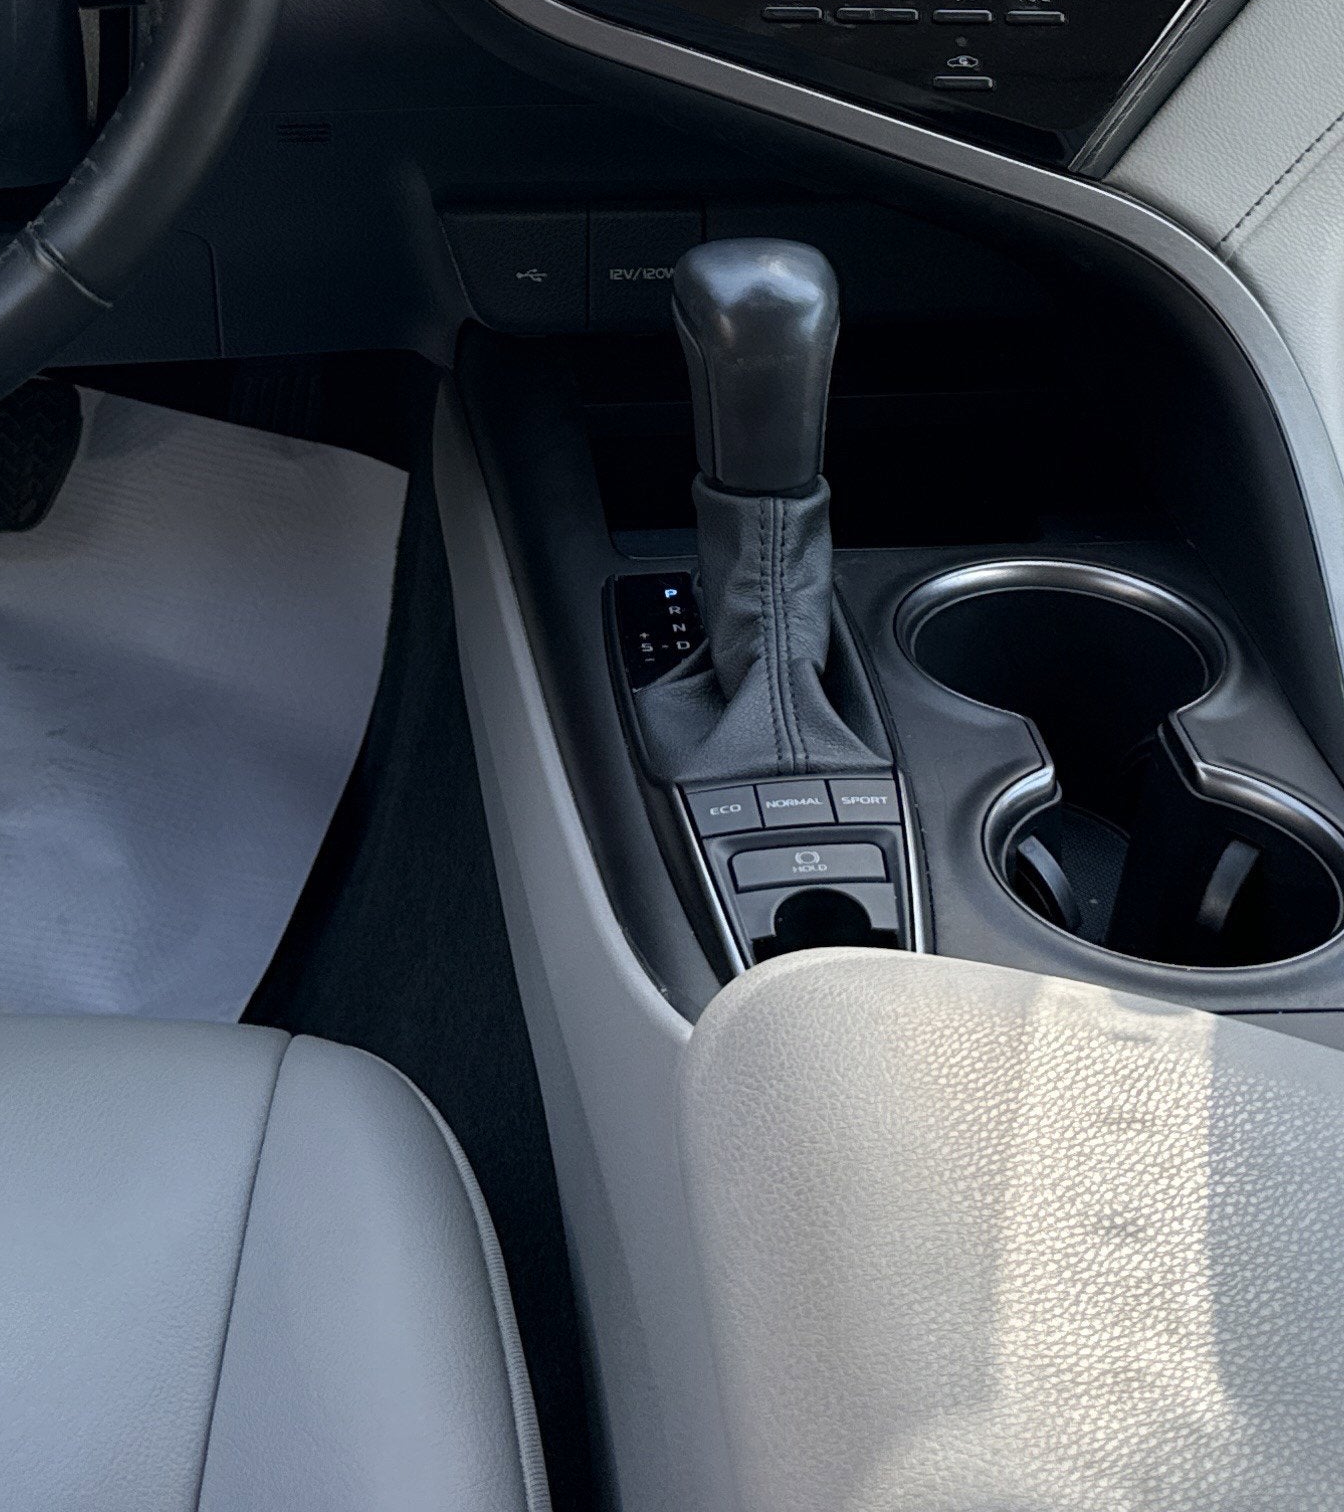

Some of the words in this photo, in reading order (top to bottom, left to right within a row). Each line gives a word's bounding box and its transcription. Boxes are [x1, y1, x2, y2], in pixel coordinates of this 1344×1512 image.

[664, 589, 678, 598] P
[669, 606, 681, 615] R
[672, 623, 686, 632] N
[641, 642, 654, 652] S
[676, 641, 690, 650] D
[766, 797, 824, 809] NORMAL
[841, 796, 888, 805] SPORT
[709, 803, 742, 816] ECO
[792, 863, 828, 874] HOLD
